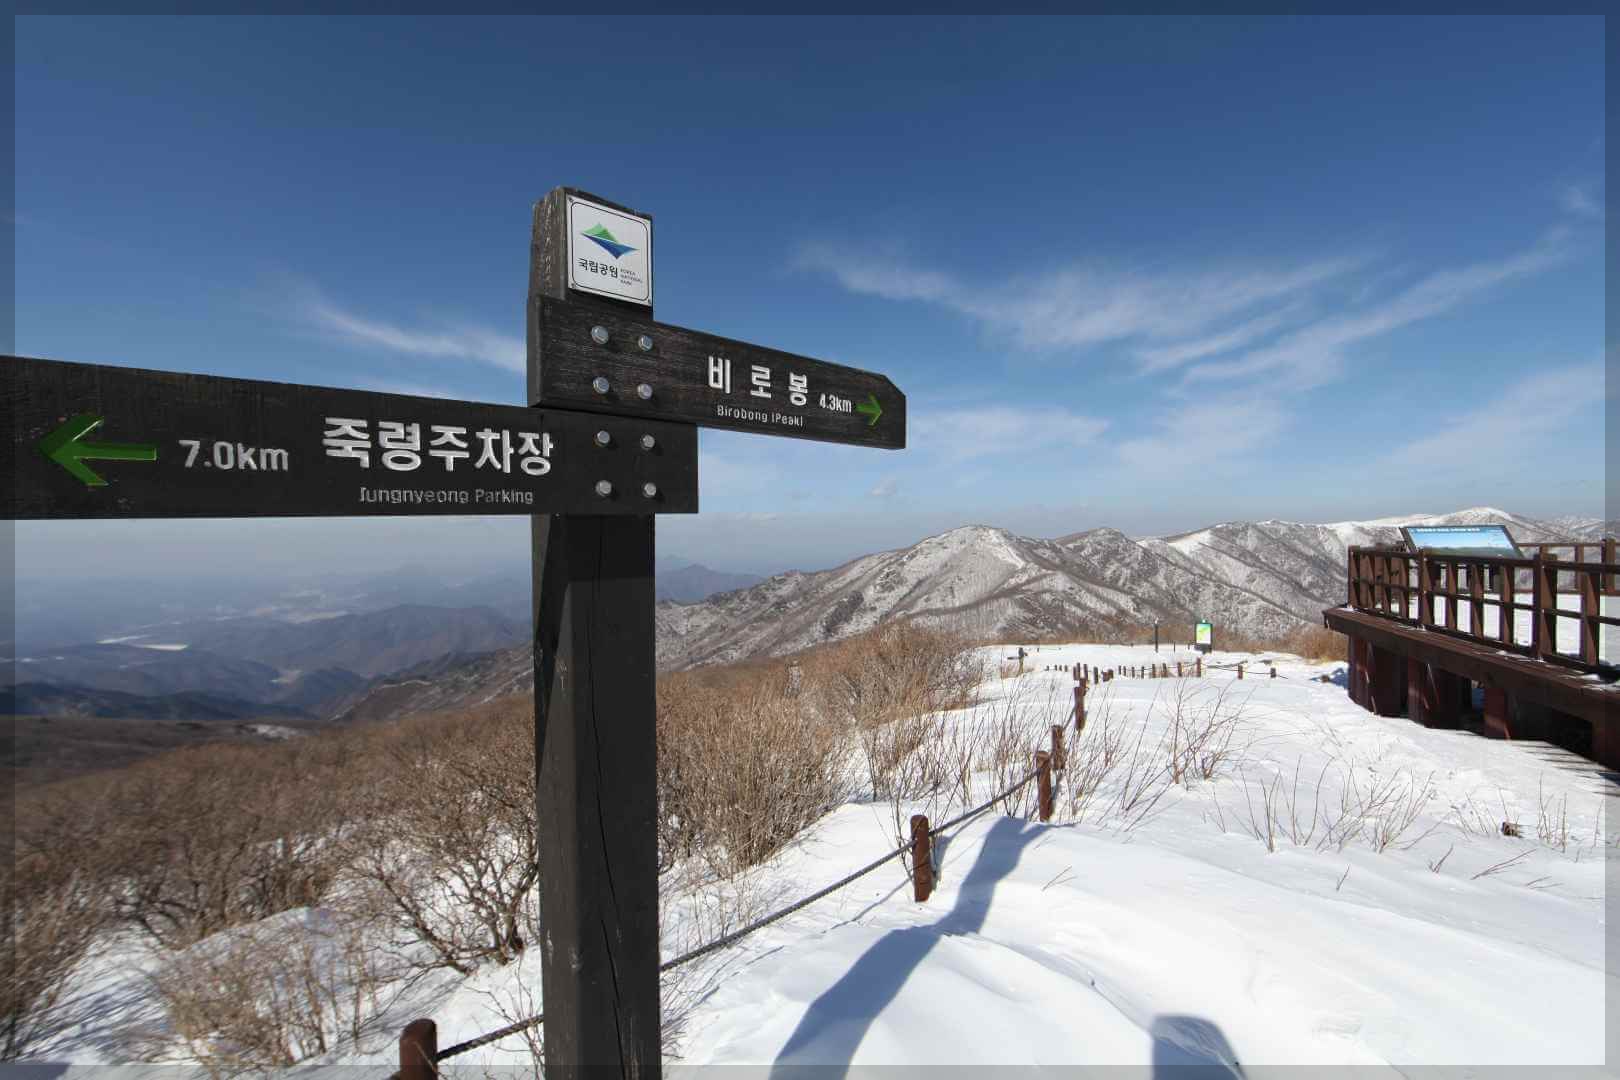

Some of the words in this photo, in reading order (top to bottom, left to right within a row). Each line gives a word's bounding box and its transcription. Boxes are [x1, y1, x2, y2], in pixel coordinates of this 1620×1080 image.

[578, 257, 618, 279] 국립공원
[819, 393, 852, 413] 4.3km
[717, 404, 768, 423] Birobong
[178, 438, 289, 472] 7.0km
[322, 416, 554, 476] 죽령주차장
[359, 486, 469, 504] Jungnyeong
[475, 488, 534, 505] Parking
